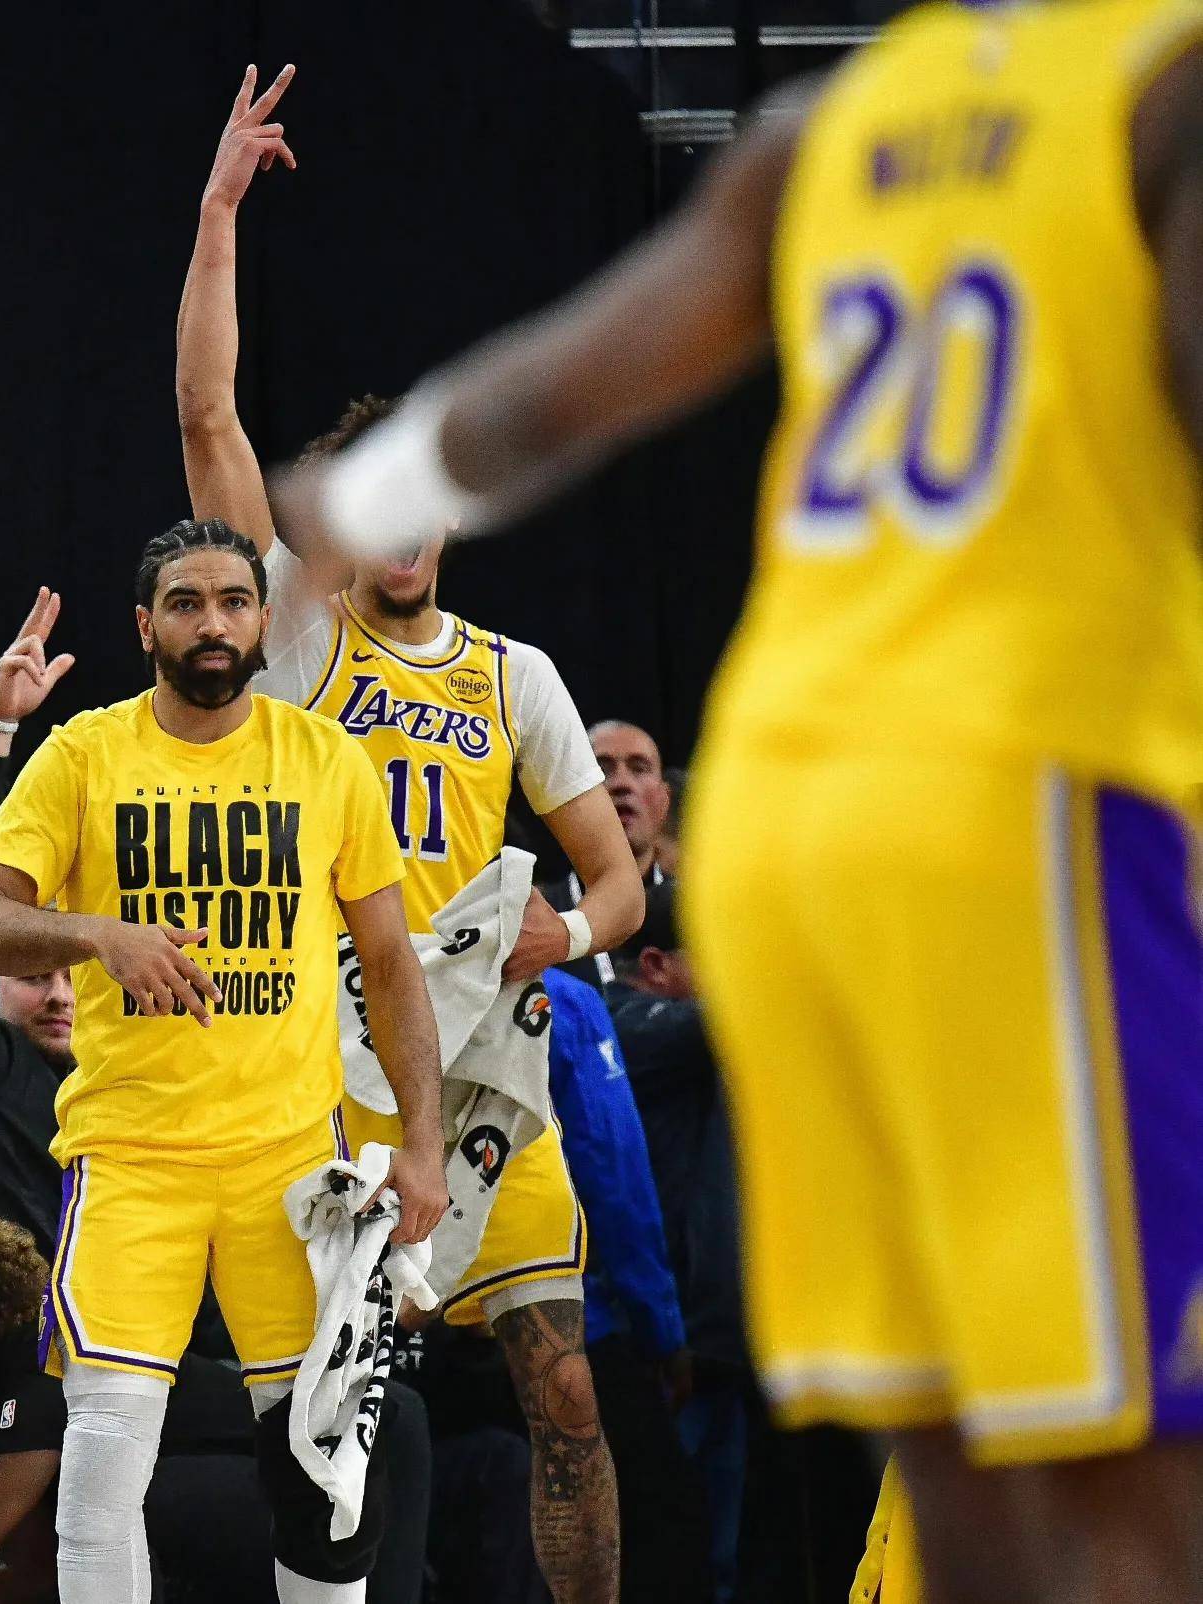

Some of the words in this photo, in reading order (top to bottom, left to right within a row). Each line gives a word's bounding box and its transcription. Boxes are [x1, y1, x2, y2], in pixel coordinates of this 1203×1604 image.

[789, 254, 1029, 536] 20
[337, 674, 492, 761] LAKERS
[449, 676, 490, 695] bibigo
[135, 784, 218, 796] BUILT
[243, 783, 272, 794] BY
[385, 757, 448, 861] 11
[115, 800, 302, 890] BLACK
[212, 970, 296, 1016] VOICES
